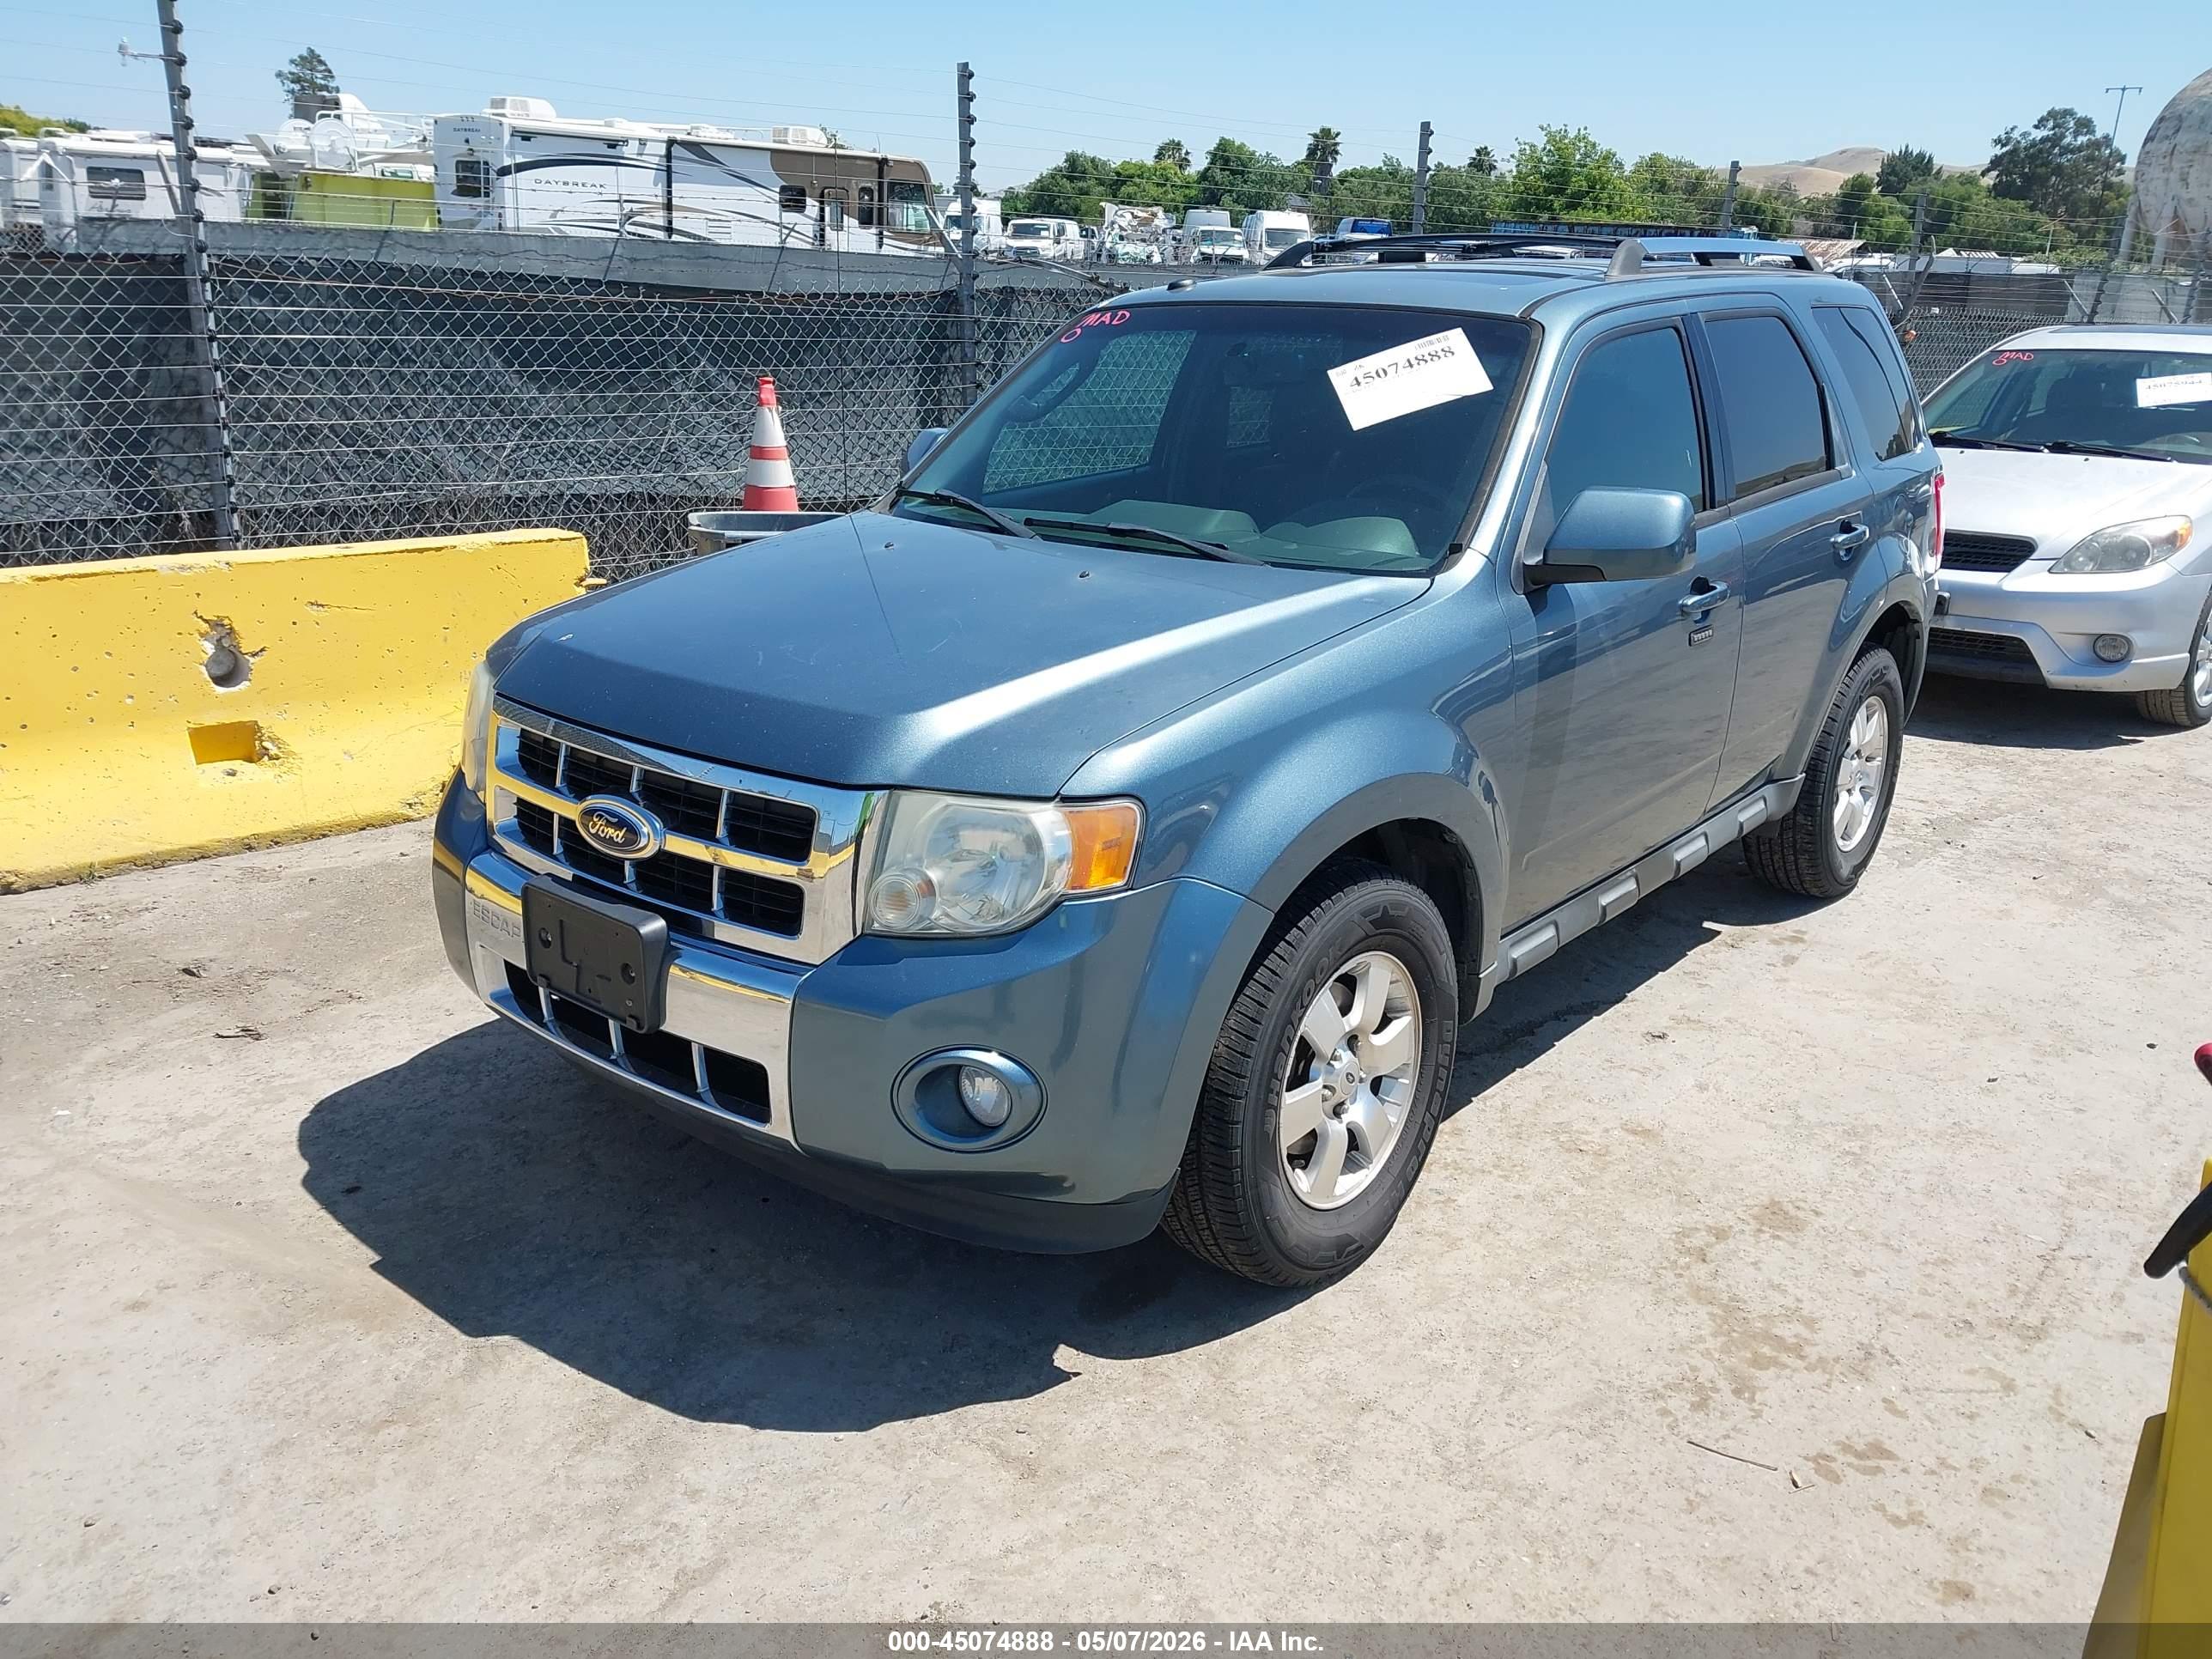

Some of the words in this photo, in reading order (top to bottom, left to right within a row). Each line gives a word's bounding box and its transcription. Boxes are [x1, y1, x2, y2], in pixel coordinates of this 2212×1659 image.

[534, 178, 607, 189] DAYBREAK
[1075, 310, 1131, 327] MAD
[1349, 345, 1455, 387] 45074888
[588, 811, 628, 844] Ford
[472, 898, 522, 939] ESCAP
